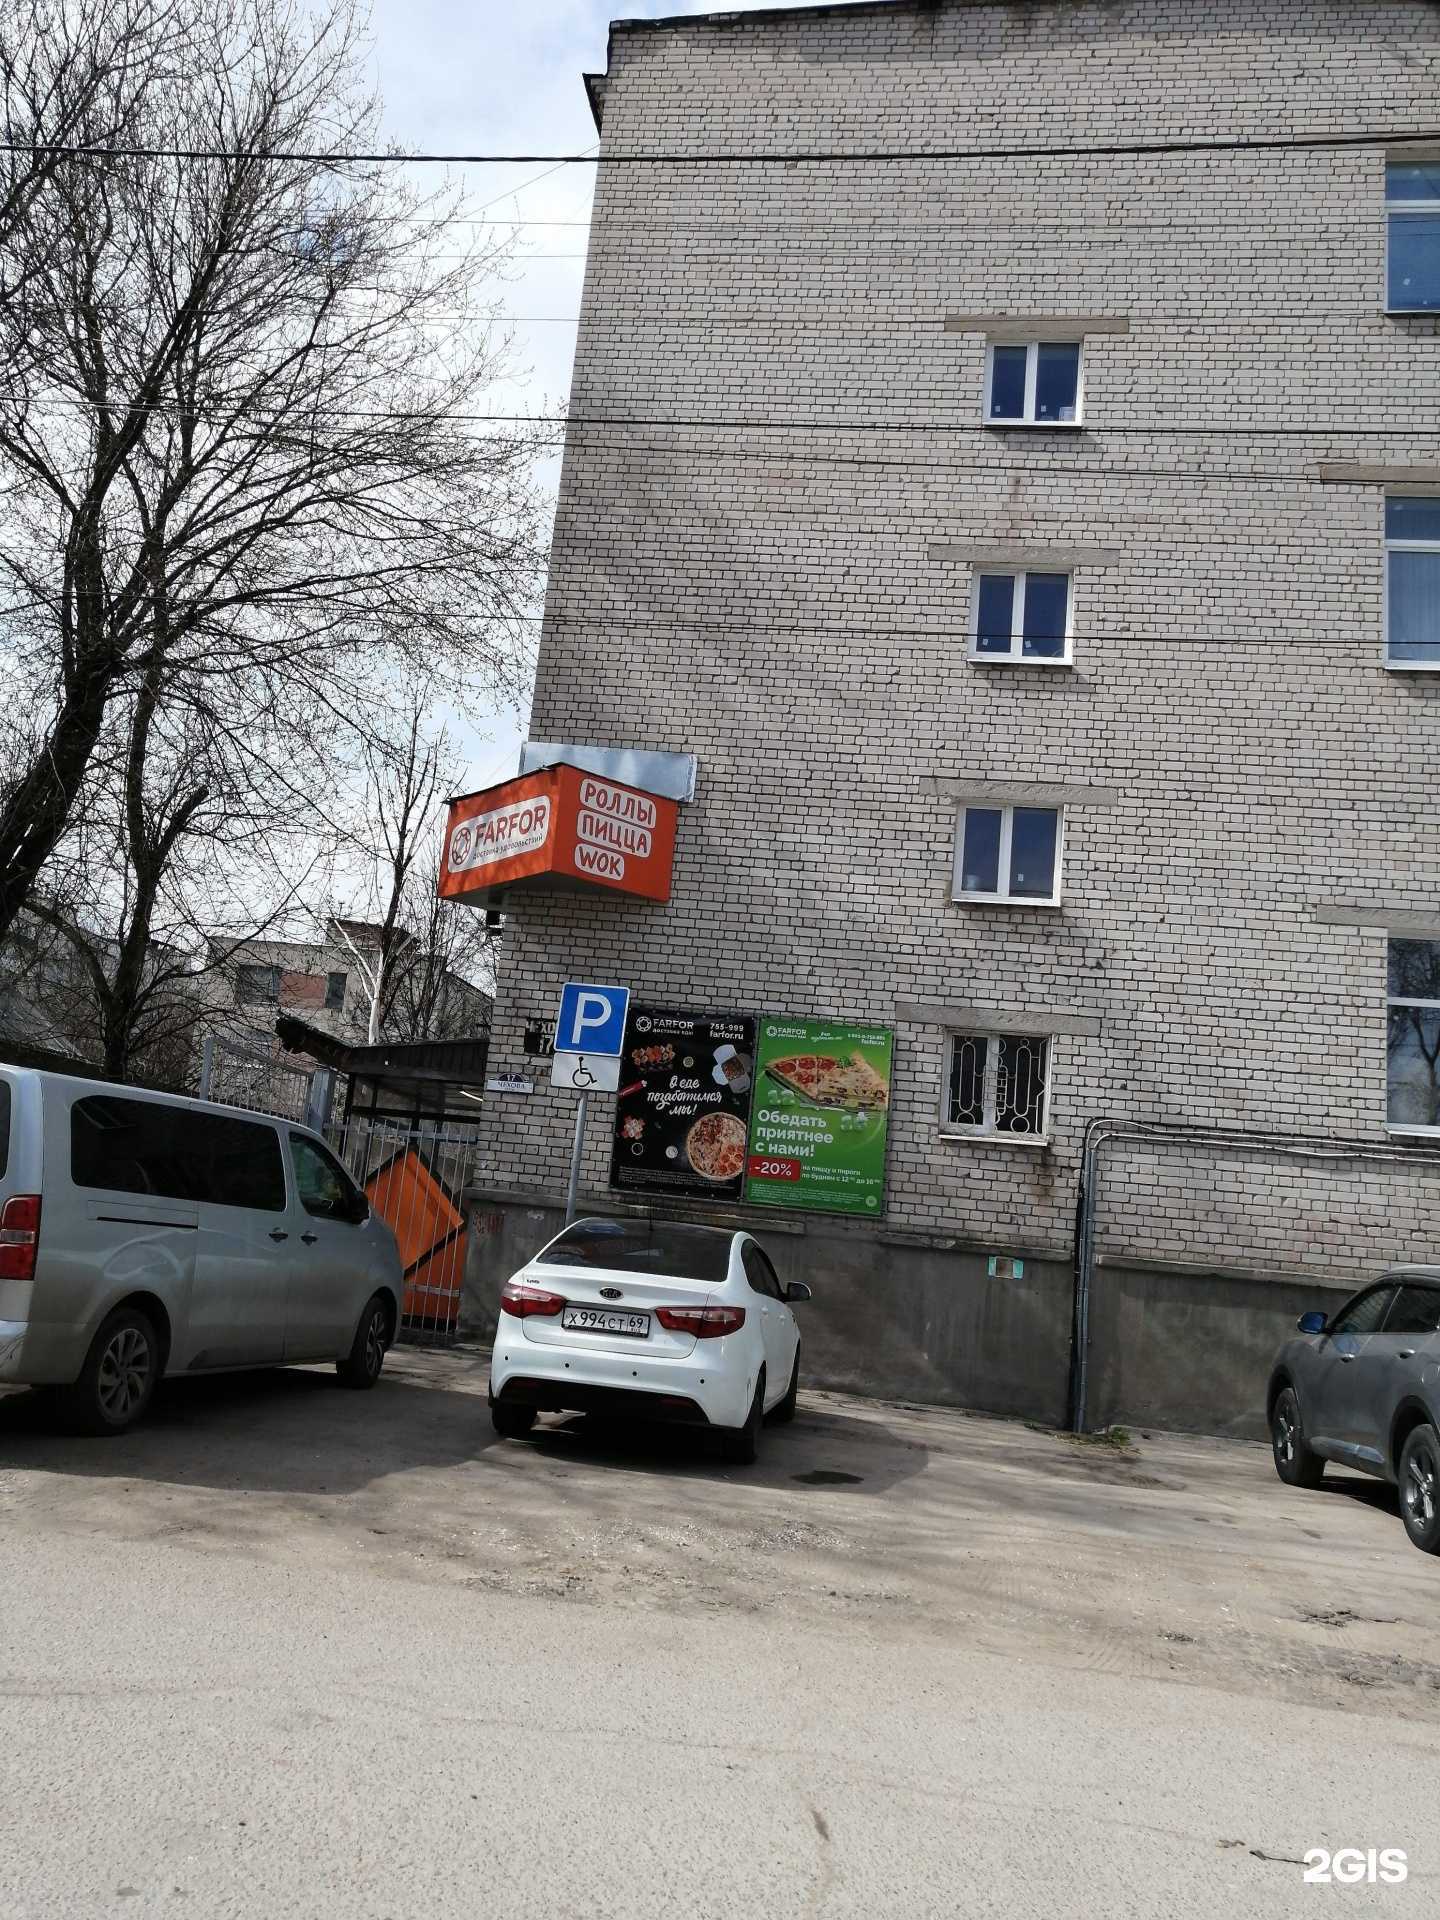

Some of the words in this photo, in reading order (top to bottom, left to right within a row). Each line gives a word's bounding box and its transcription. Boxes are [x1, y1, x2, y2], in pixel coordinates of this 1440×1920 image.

[585, 782, 653, 825] РОЛЛЫ
[475, 804, 547, 848] FARFOR
[582, 814, 648, 853] ПИЦЦА
[579, 845, 621, 876] WOK
[571, 992, 612, 1044] P
[653, 1019, 694, 1030] FARFOR
[709, 1030, 744, 1040] farfor.ru
[710, 1023, 744, 1032] 755-999
[777, 1027, 807, 1036] FARFOR
[539, 1034, 554, 1054] 17
[679, 1079, 700, 1089] еде
[647, 1089, 722, 1110] позаботимся
[669, 1104, 698, 1116] мы!
[757, 1109, 827, 1128] Обедать
[756, 1126, 833, 1144] приятнее
[755, 1142, 765, 1152] с
[768, 1143, 815, 1157] нами!
[754, 1161, 792, 1176] -20%
[629, 1316, 644, 1329] 69
